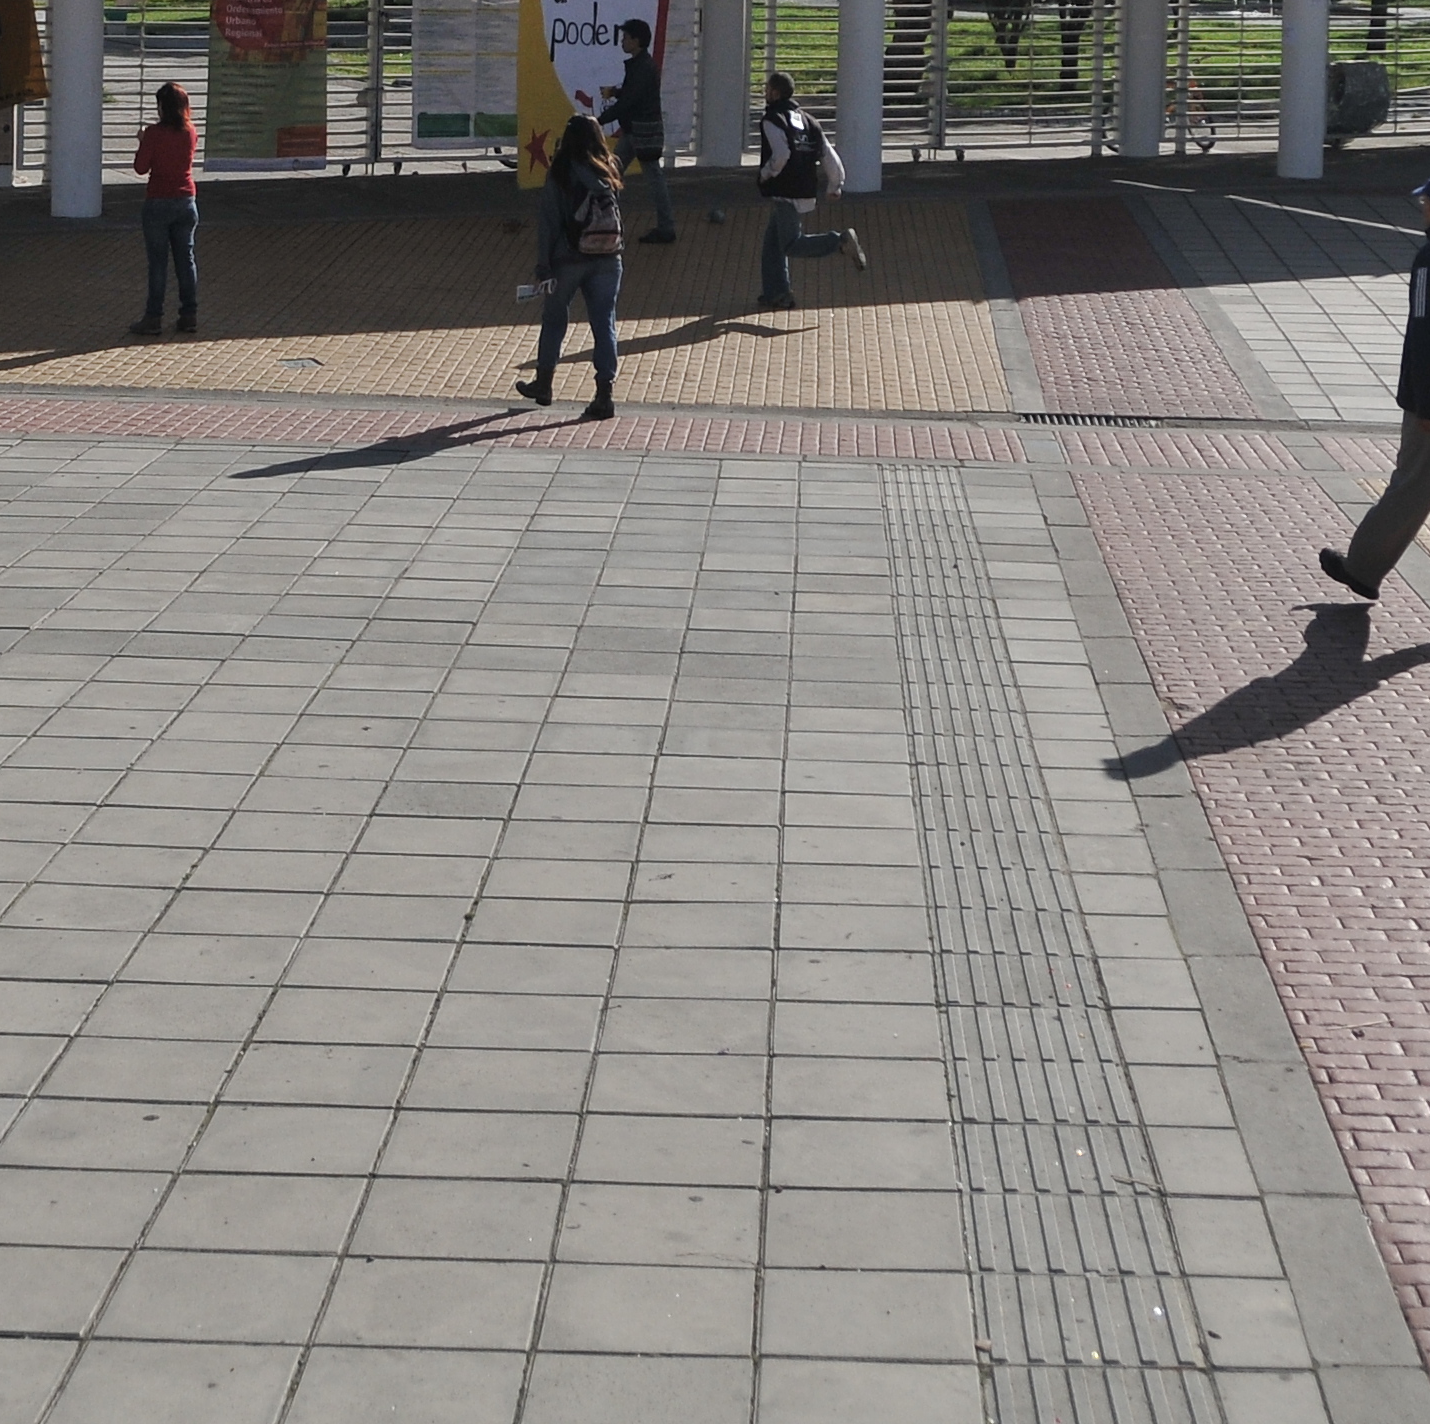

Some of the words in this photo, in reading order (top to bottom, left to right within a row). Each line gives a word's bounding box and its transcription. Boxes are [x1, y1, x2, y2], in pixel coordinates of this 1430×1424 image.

[225, 16, 257, 25] Urbano
[225, 28, 263, 38] Regional
[550, 1, 623, 62] poder
